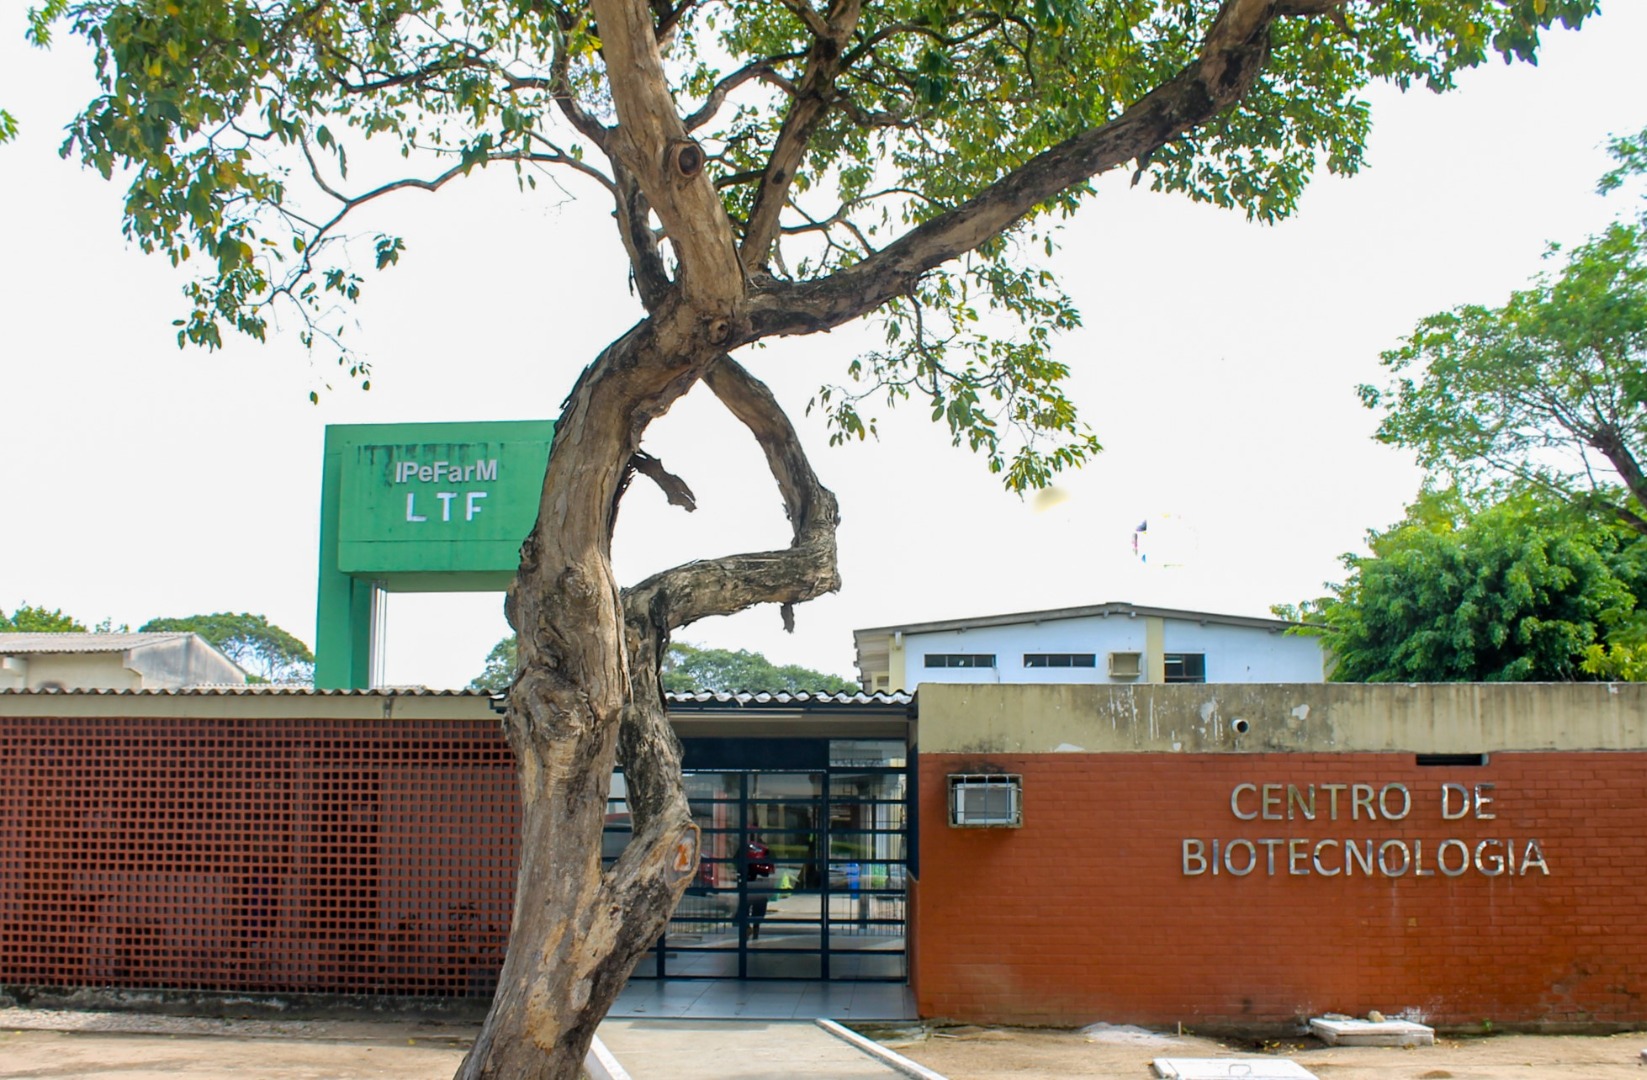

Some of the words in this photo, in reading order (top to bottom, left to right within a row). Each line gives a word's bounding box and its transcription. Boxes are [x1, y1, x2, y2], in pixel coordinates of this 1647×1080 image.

[395, 459, 498, 483] IPeFarM
[1231, 783, 1412, 821] CENTRO
[1441, 783, 1497, 821] DE
[1182, 838, 1551, 877] BIOTECNOLOGIA
